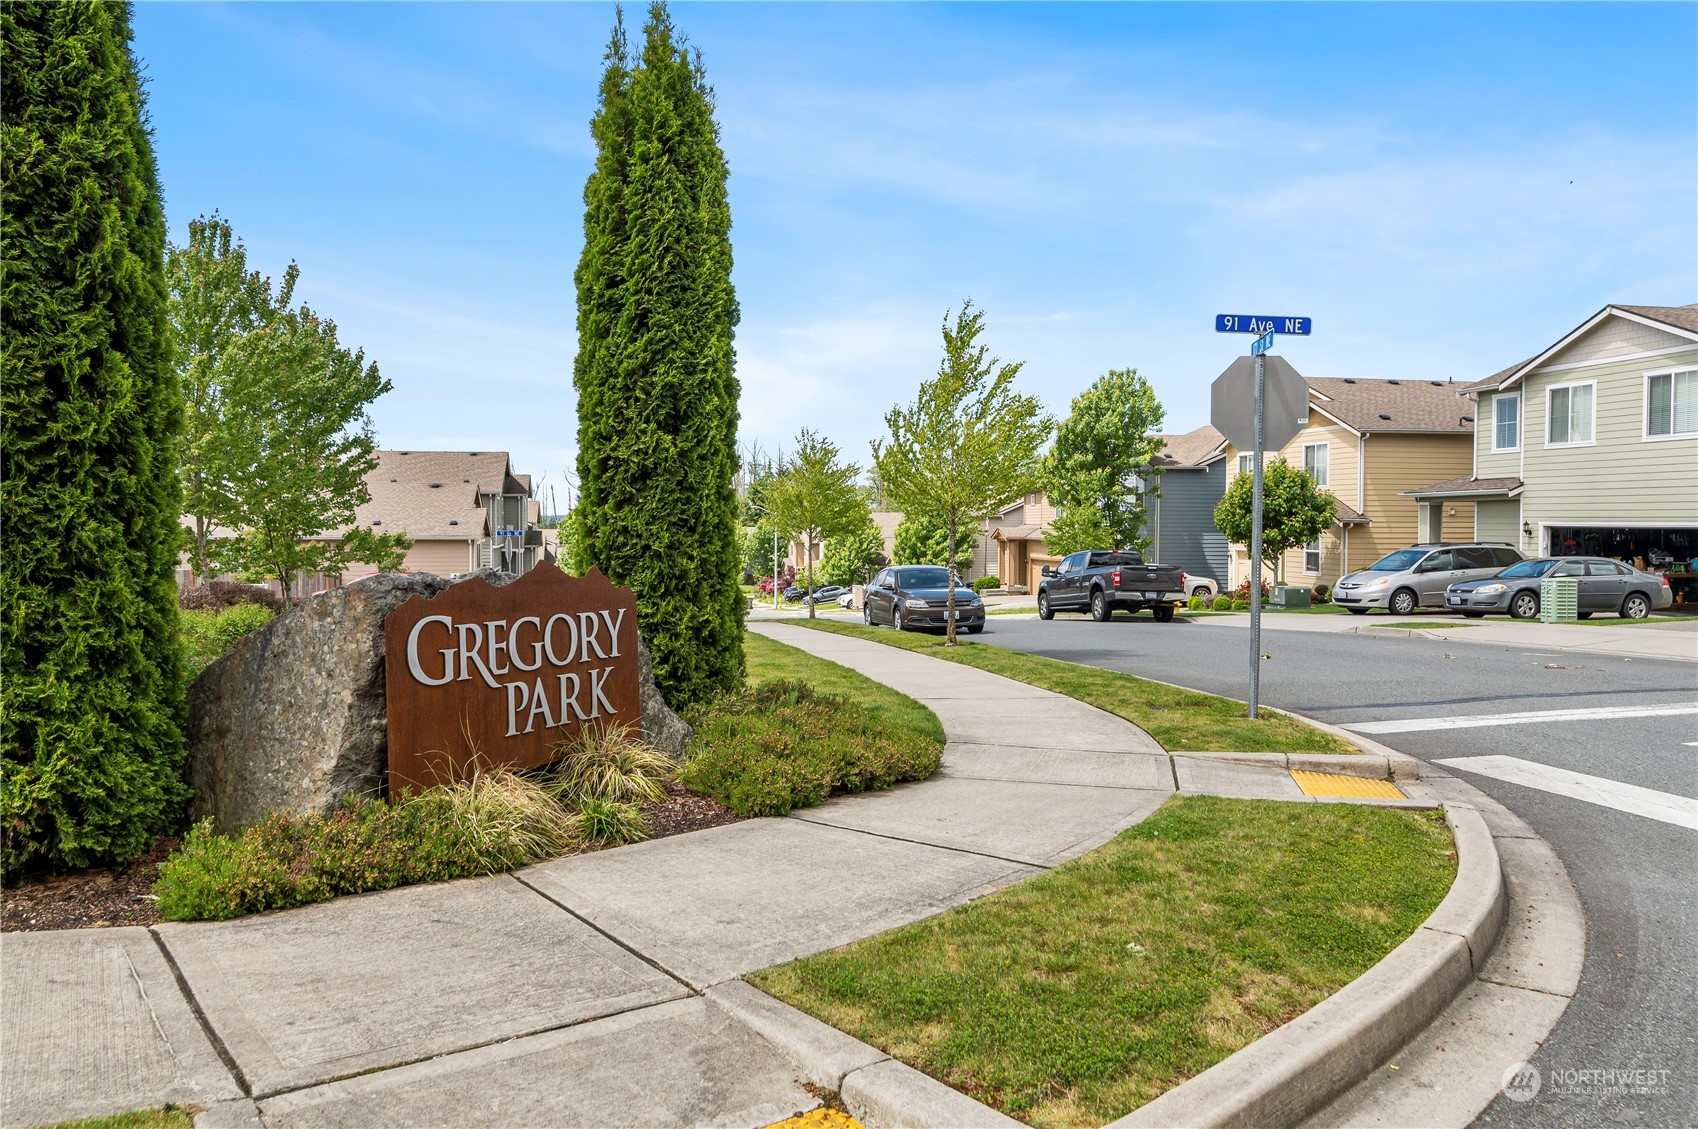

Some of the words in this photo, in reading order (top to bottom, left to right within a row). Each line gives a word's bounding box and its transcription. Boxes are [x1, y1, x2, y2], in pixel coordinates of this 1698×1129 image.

[1224, 316, 1239, 331] 91
[1249, 317, 1274, 332] Ave
[1285, 318, 1303, 333] NE
[407, 608, 627, 689] GREGORY
[503, 666, 618, 738] PARK
